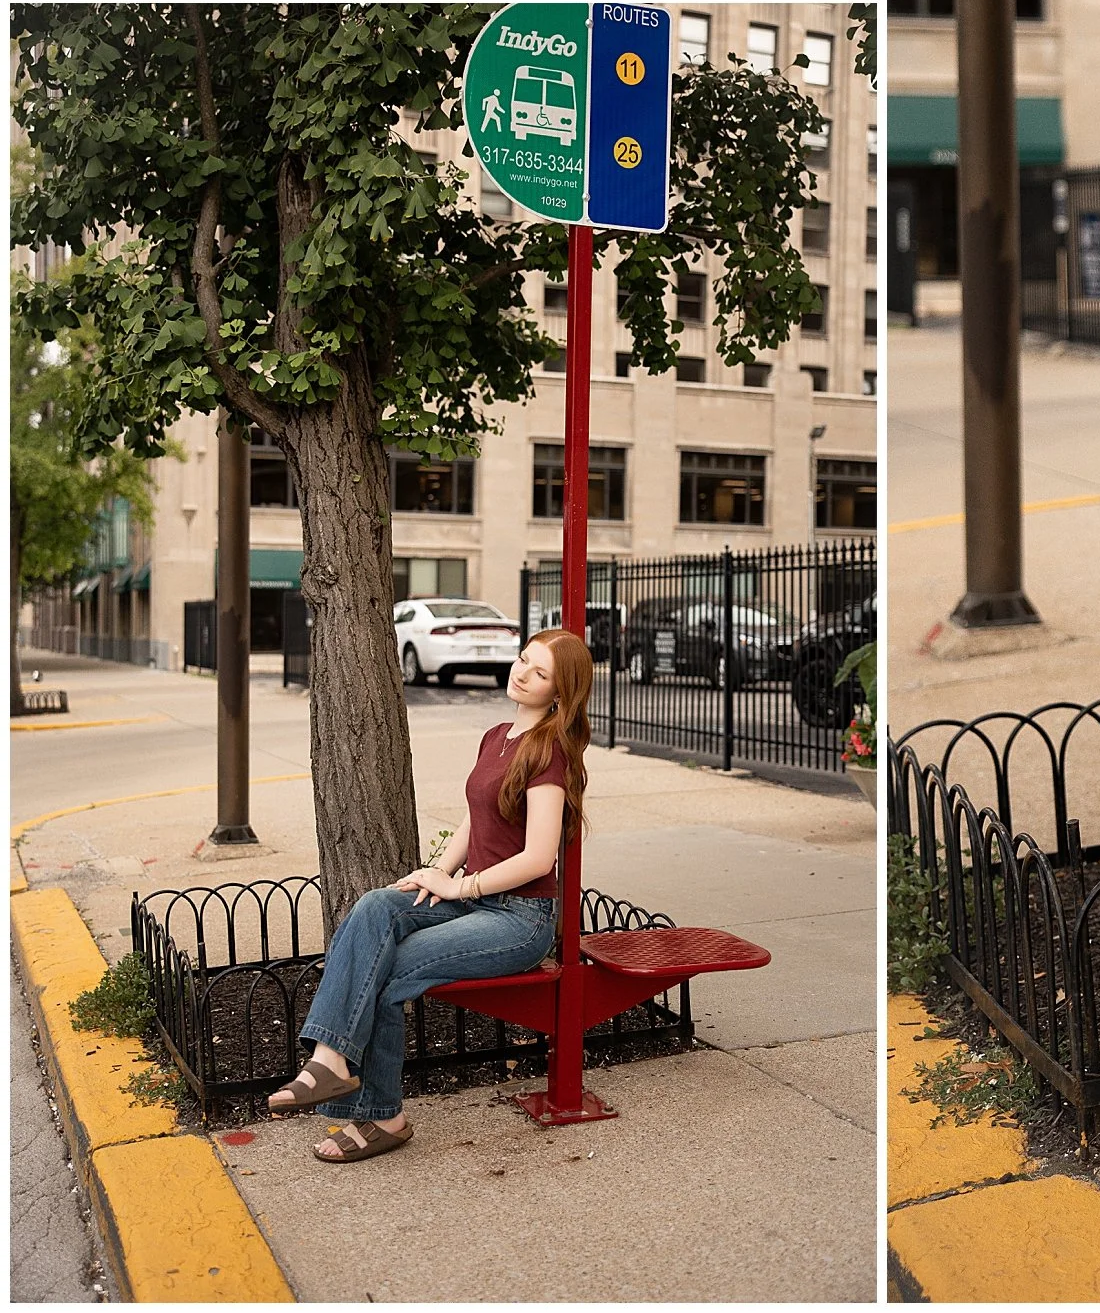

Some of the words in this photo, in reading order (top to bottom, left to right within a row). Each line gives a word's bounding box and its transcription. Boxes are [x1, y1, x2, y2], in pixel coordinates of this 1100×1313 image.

[602, 4, 659, 28] ROUTES
[496, 25, 578, 57] IndyGo
[620, 58, 639, 79] 11
[482, 145, 584, 175] 317-635-3344
[617, 142, 639, 164] 25
[509, 172, 578, 189] www.indygo.net
[540, 195, 567, 209] 10129
